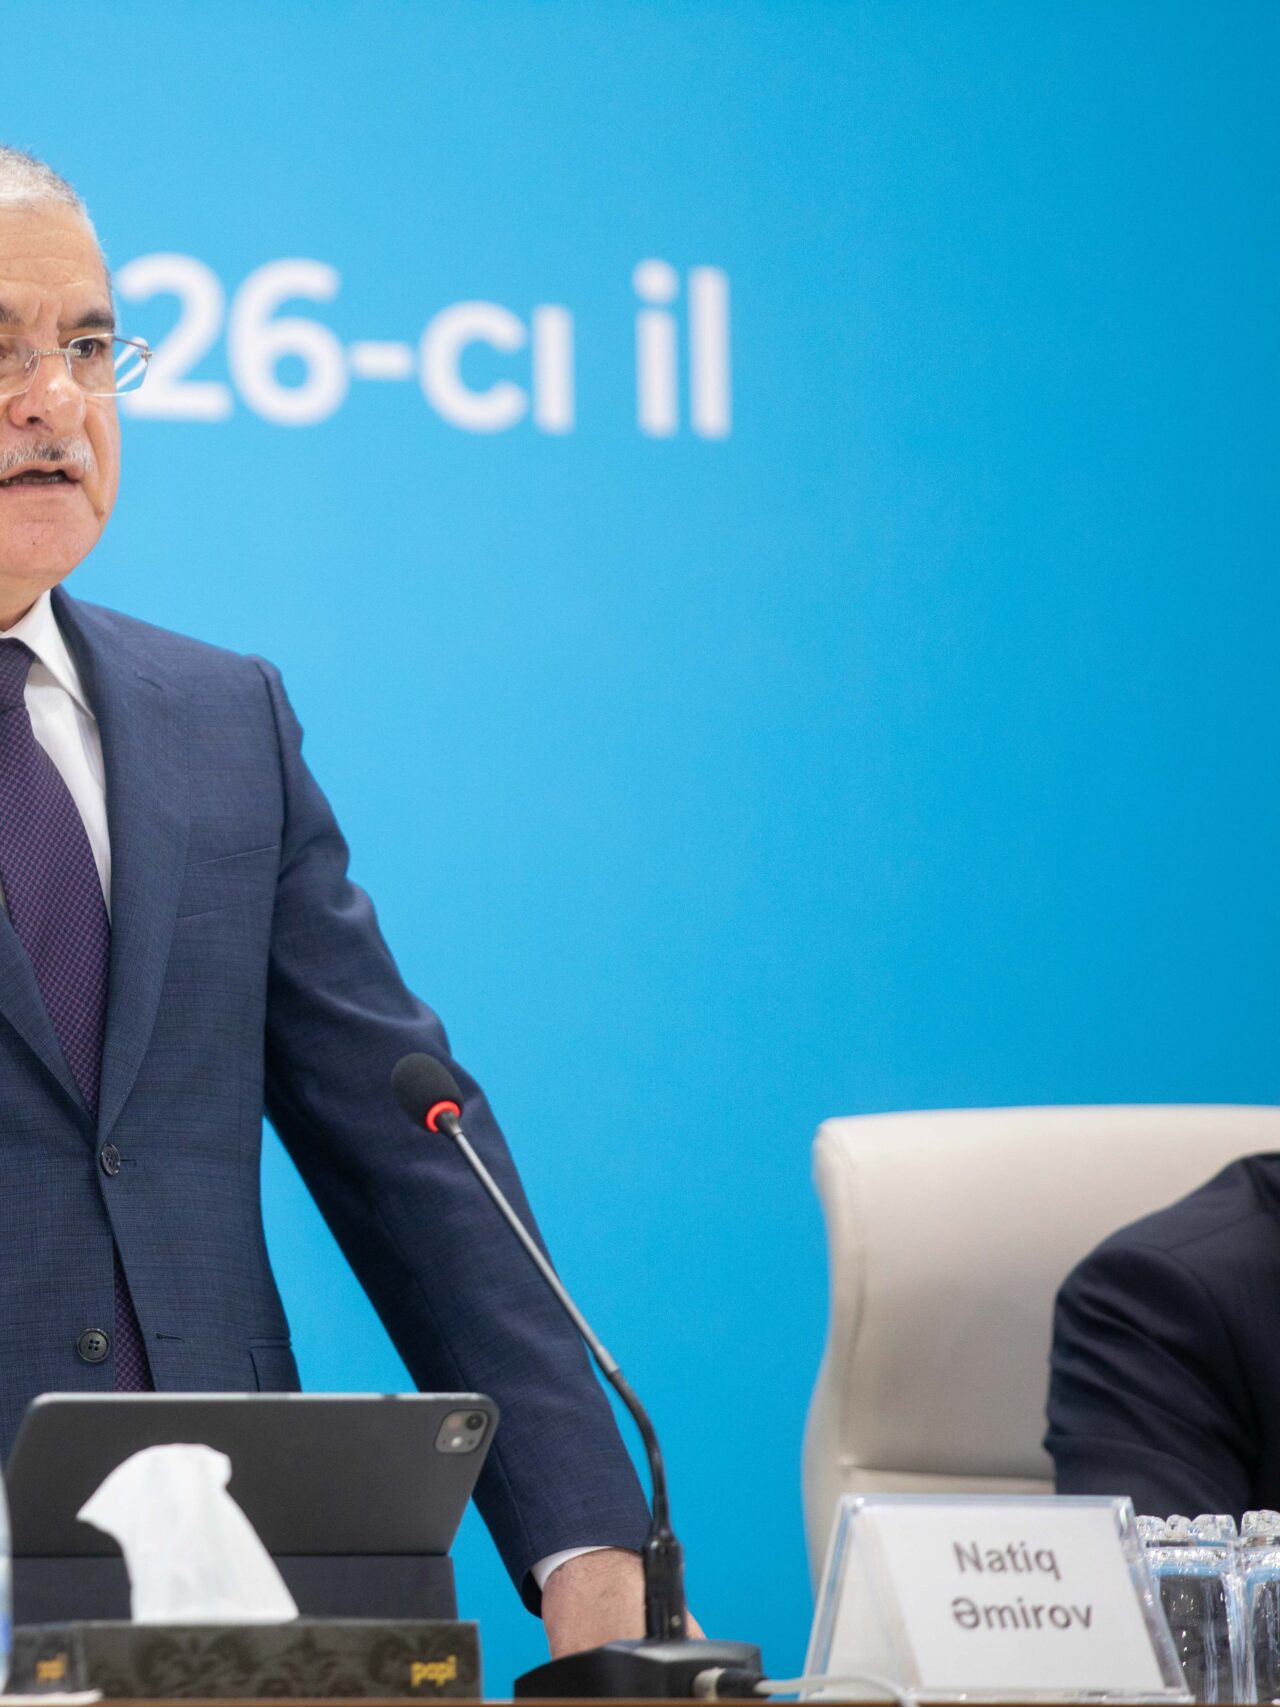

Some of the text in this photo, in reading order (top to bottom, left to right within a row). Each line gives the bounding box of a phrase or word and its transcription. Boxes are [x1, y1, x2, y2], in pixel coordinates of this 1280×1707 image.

[113, 252, 573, 432] 26-cı
[634, 260, 730, 438] il
[953, 1541, 1061, 1581] Natiq
[951, 1597, 1092, 1630] Əmirov
